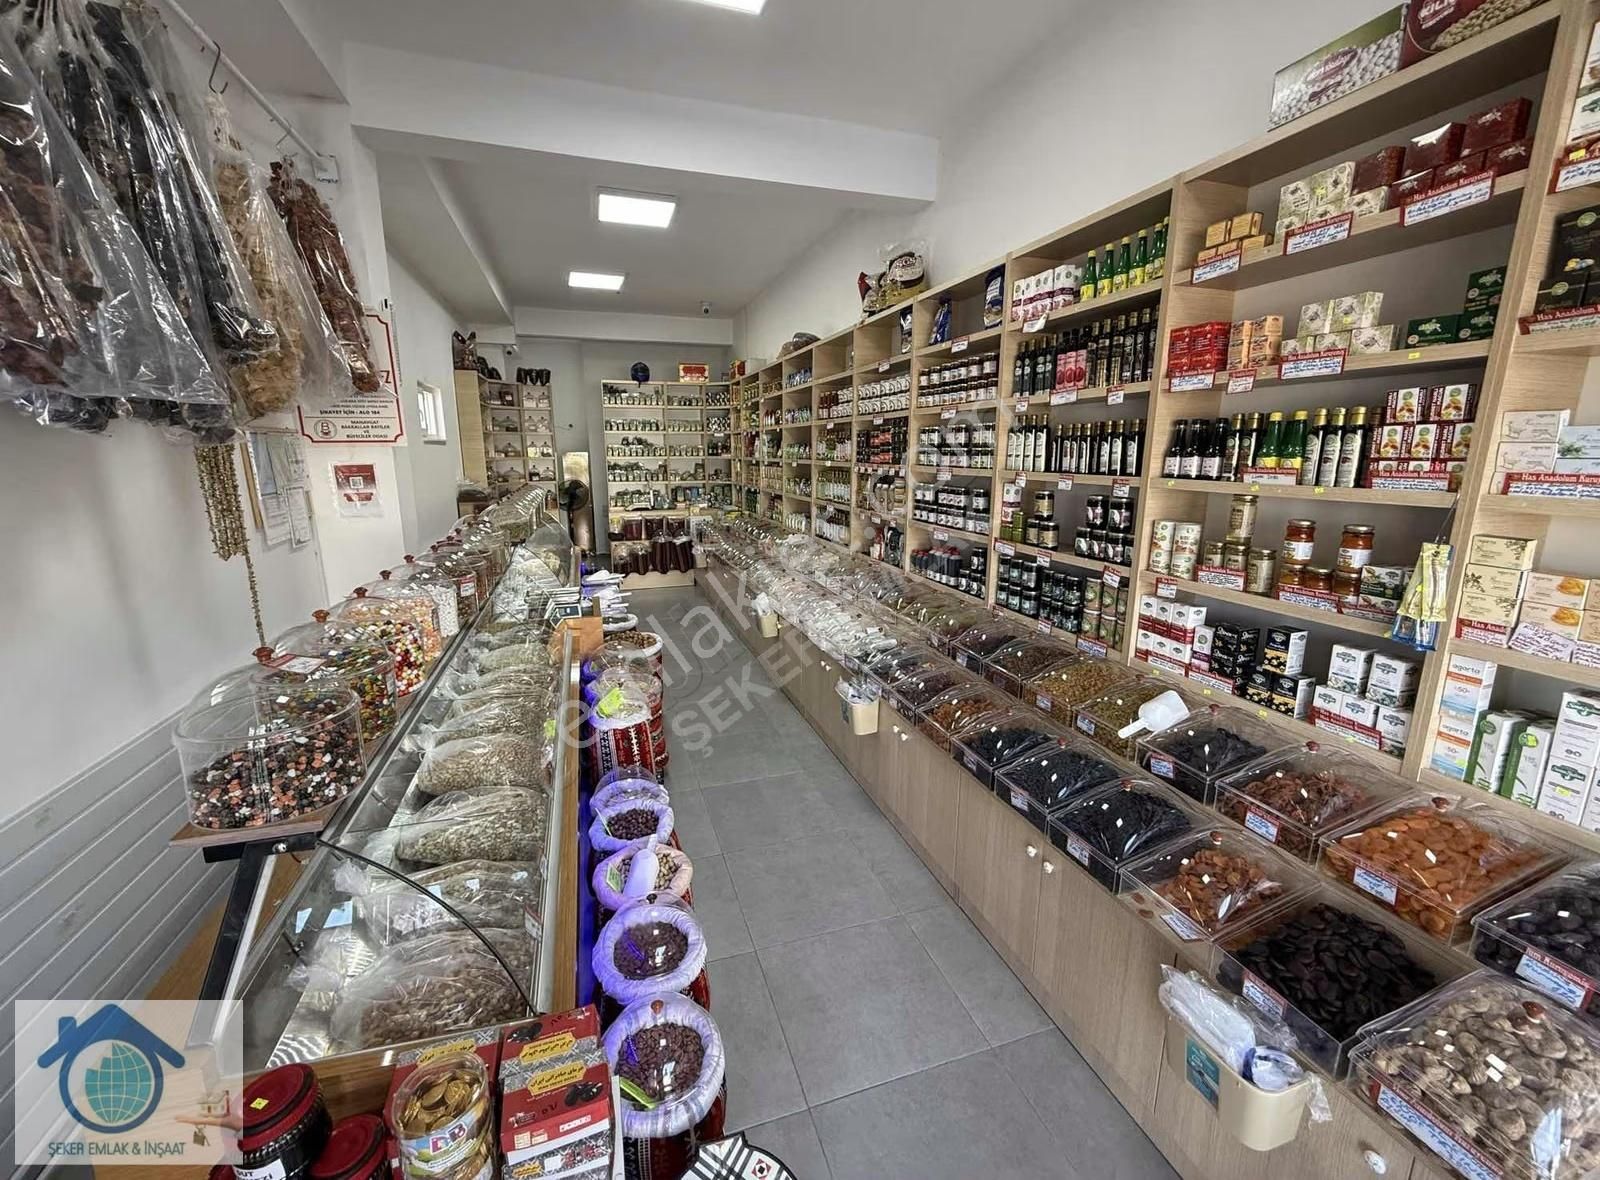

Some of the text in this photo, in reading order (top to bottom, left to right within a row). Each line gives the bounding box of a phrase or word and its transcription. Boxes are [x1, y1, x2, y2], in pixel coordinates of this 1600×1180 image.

[1537, 311, 1554, 321] Has
[1521, 473, 1537, 481] Has
[1471, 620, 1486, 629] Has
